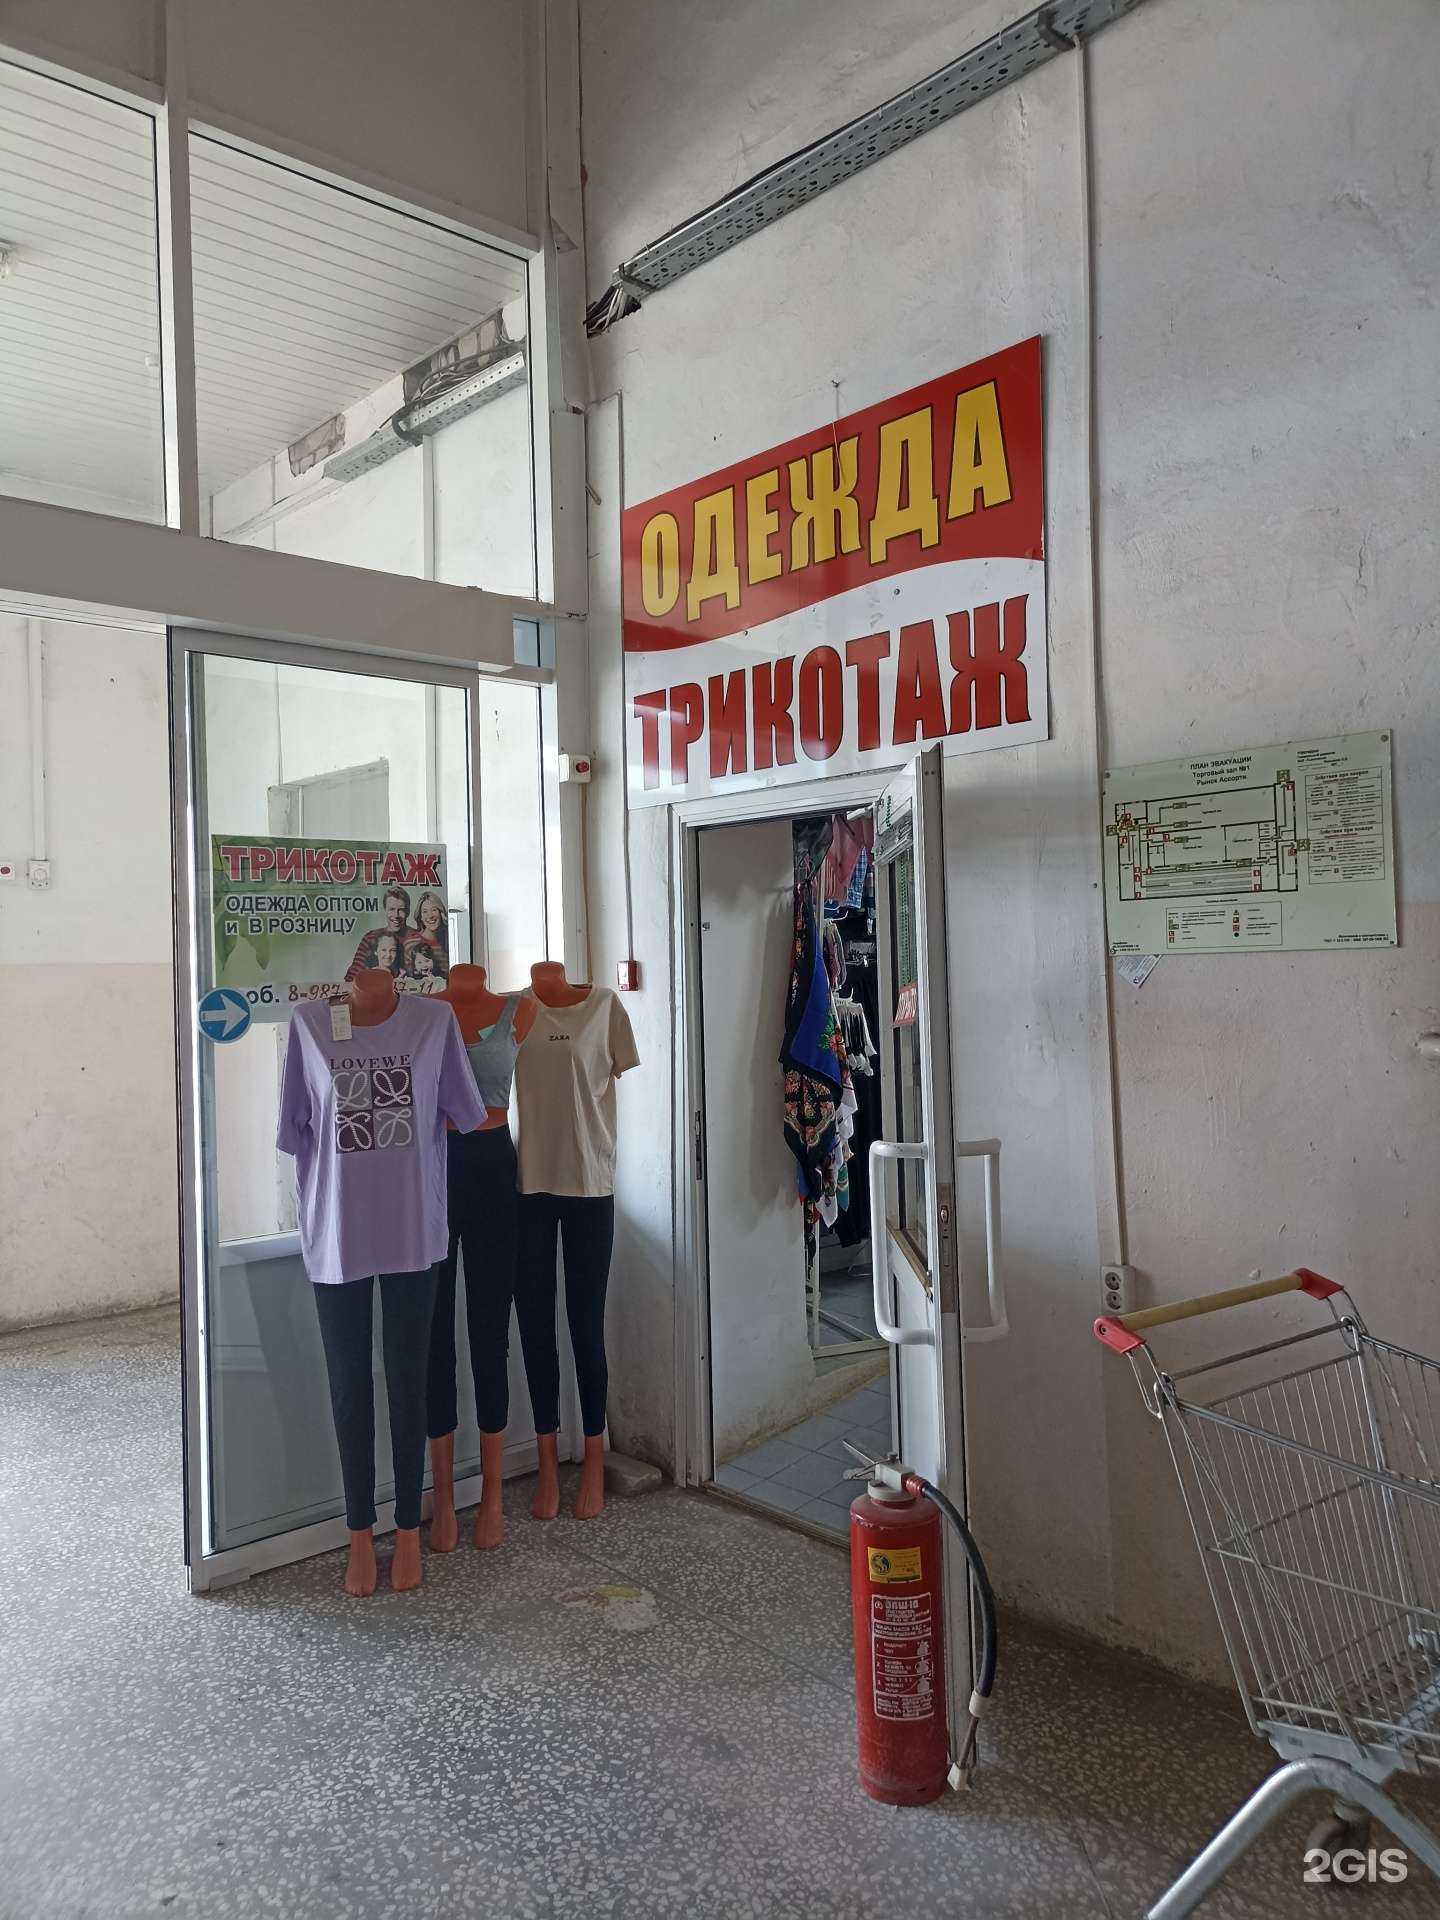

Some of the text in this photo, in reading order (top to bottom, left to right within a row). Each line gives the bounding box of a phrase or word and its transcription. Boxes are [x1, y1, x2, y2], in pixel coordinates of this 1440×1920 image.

[640, 378, 1013, 623] ОДЕЖДА
[633, 593, 1031, 791] ТРИКОТАЖ
[1190, 756, 1252, 770] ПЛАН ЭВАКУАЦИИ
[221, 845, 442, 887] ТРИКОТАЖ
[225, 896, 379, 916] ОДЕЖДА ОПТОМ
[226, 918, 356, 936] и В РОЗНИЦУ
[330, 1053, 412, 1071] LOVEWE
